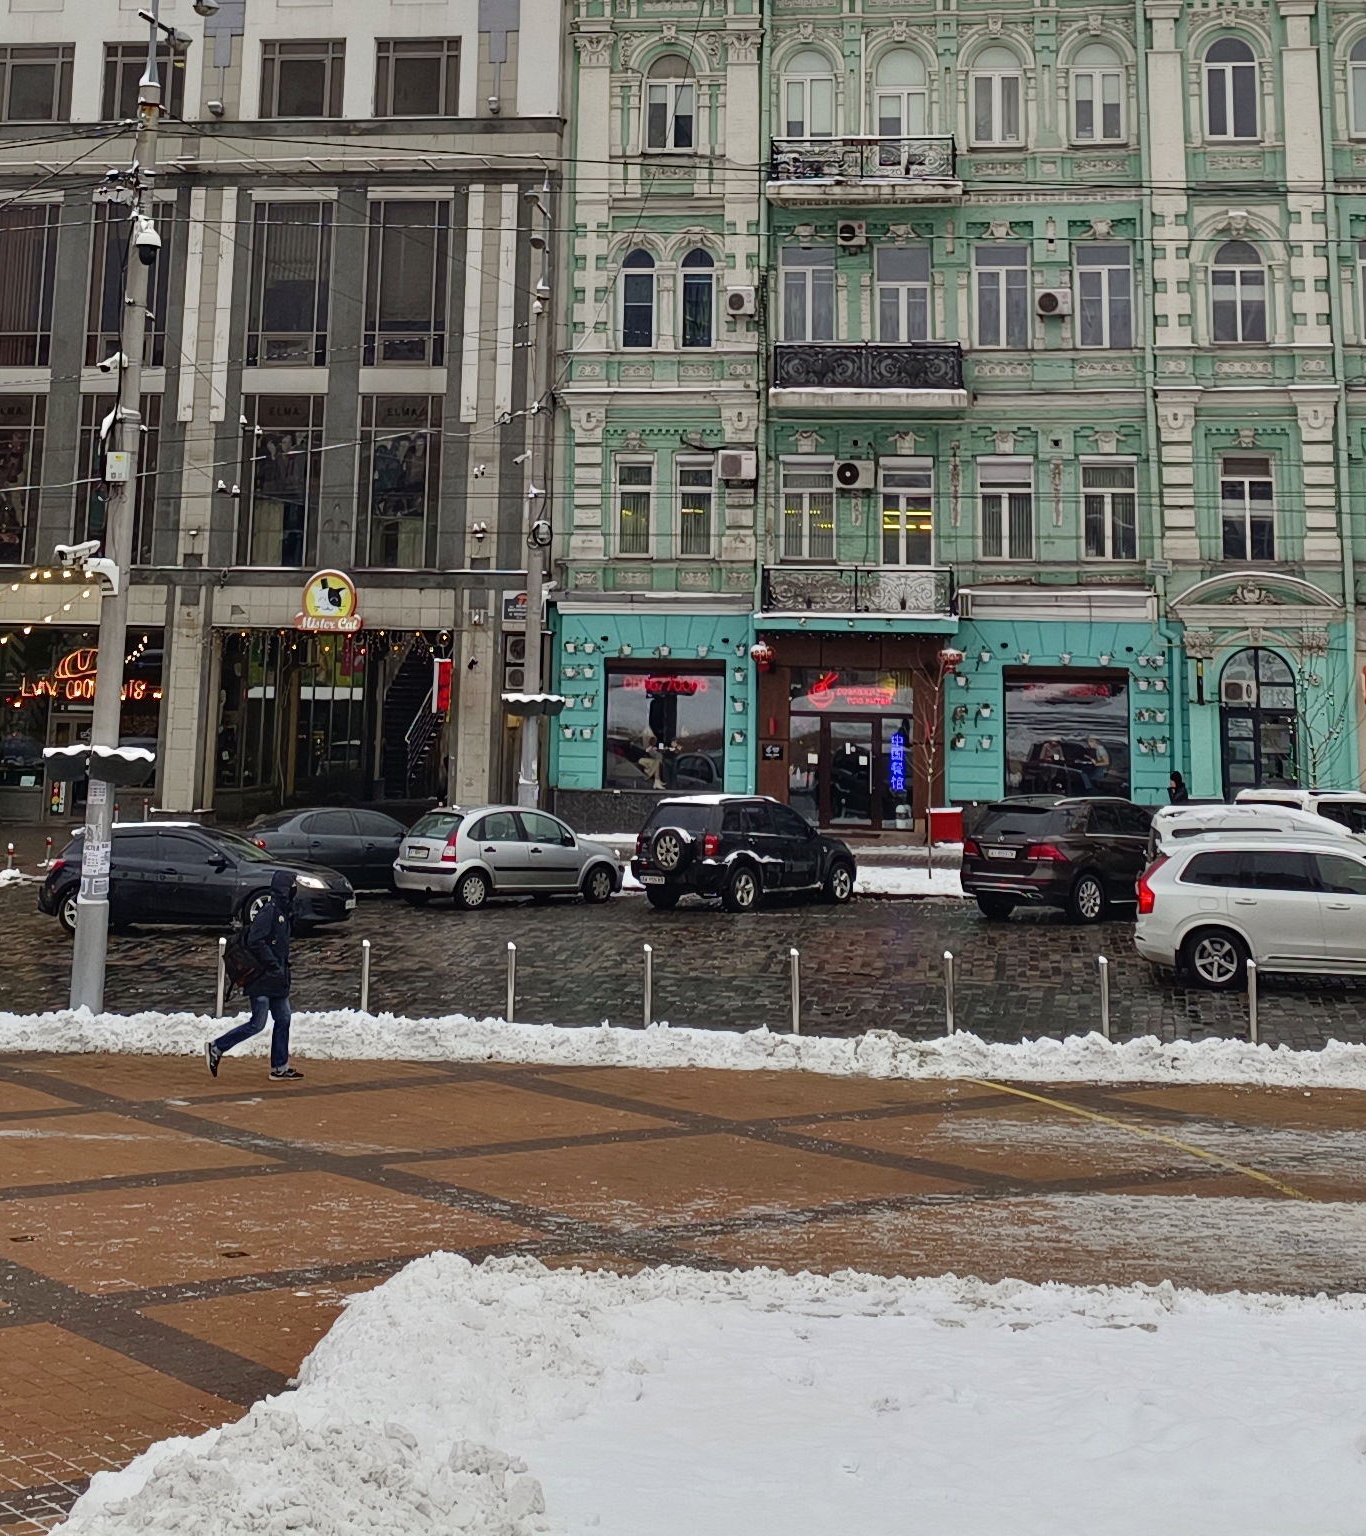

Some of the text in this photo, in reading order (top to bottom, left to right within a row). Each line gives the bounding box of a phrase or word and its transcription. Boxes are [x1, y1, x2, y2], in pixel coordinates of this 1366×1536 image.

[268, 406, 300, 416] ELMA
[386, 406, 418, 417] ELMA
[299, 616, 358, 630] Mister Cat
